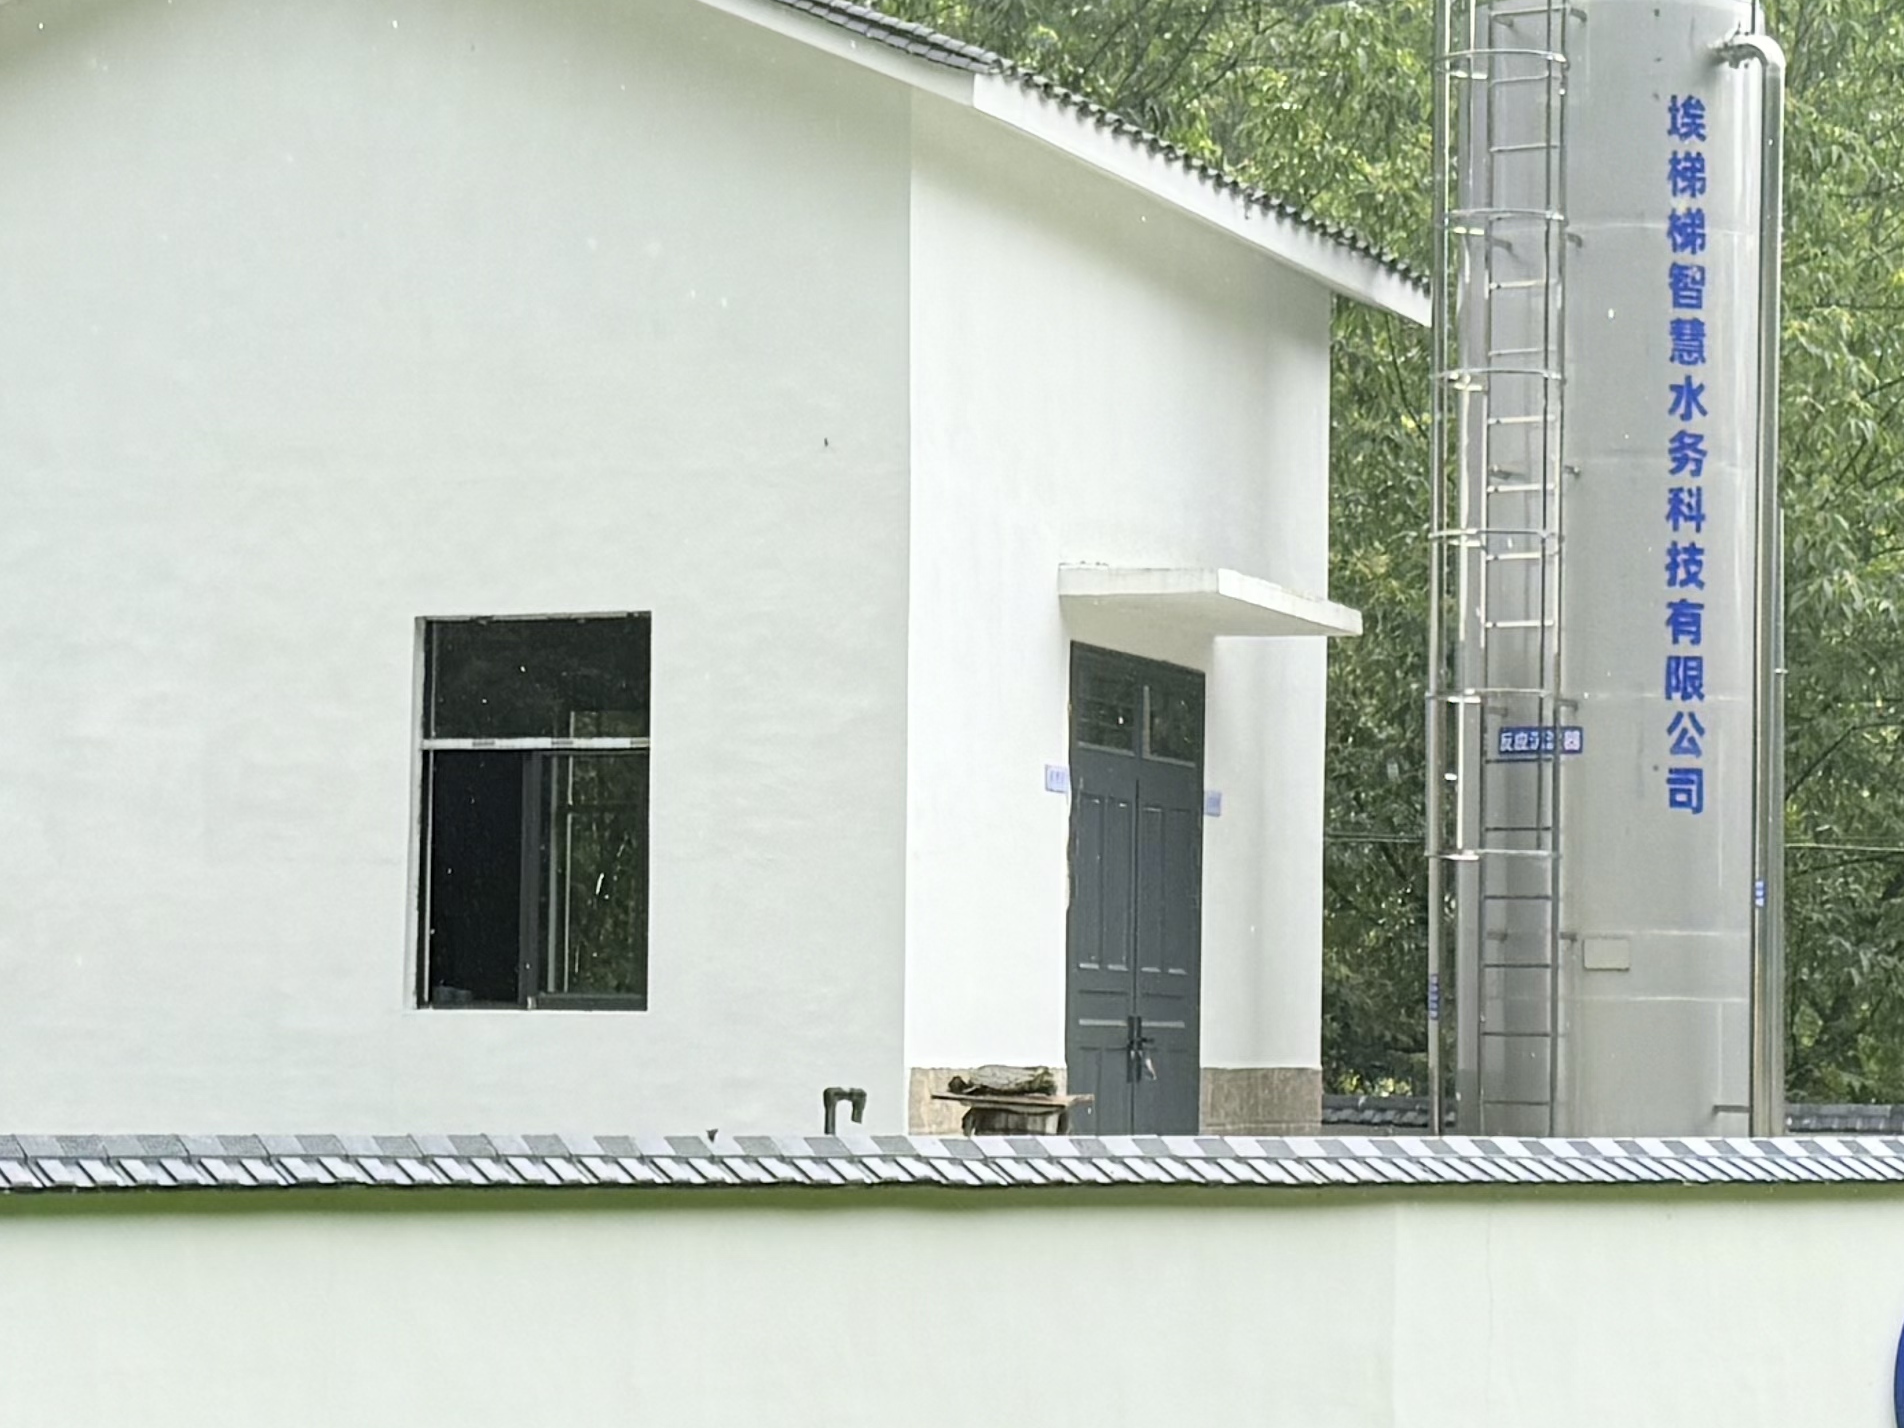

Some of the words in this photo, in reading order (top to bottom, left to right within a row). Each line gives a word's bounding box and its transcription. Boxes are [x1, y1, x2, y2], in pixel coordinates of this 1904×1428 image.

[1666, 94, 1708, 815] 埃梯梯智慧水务科技有限公司
